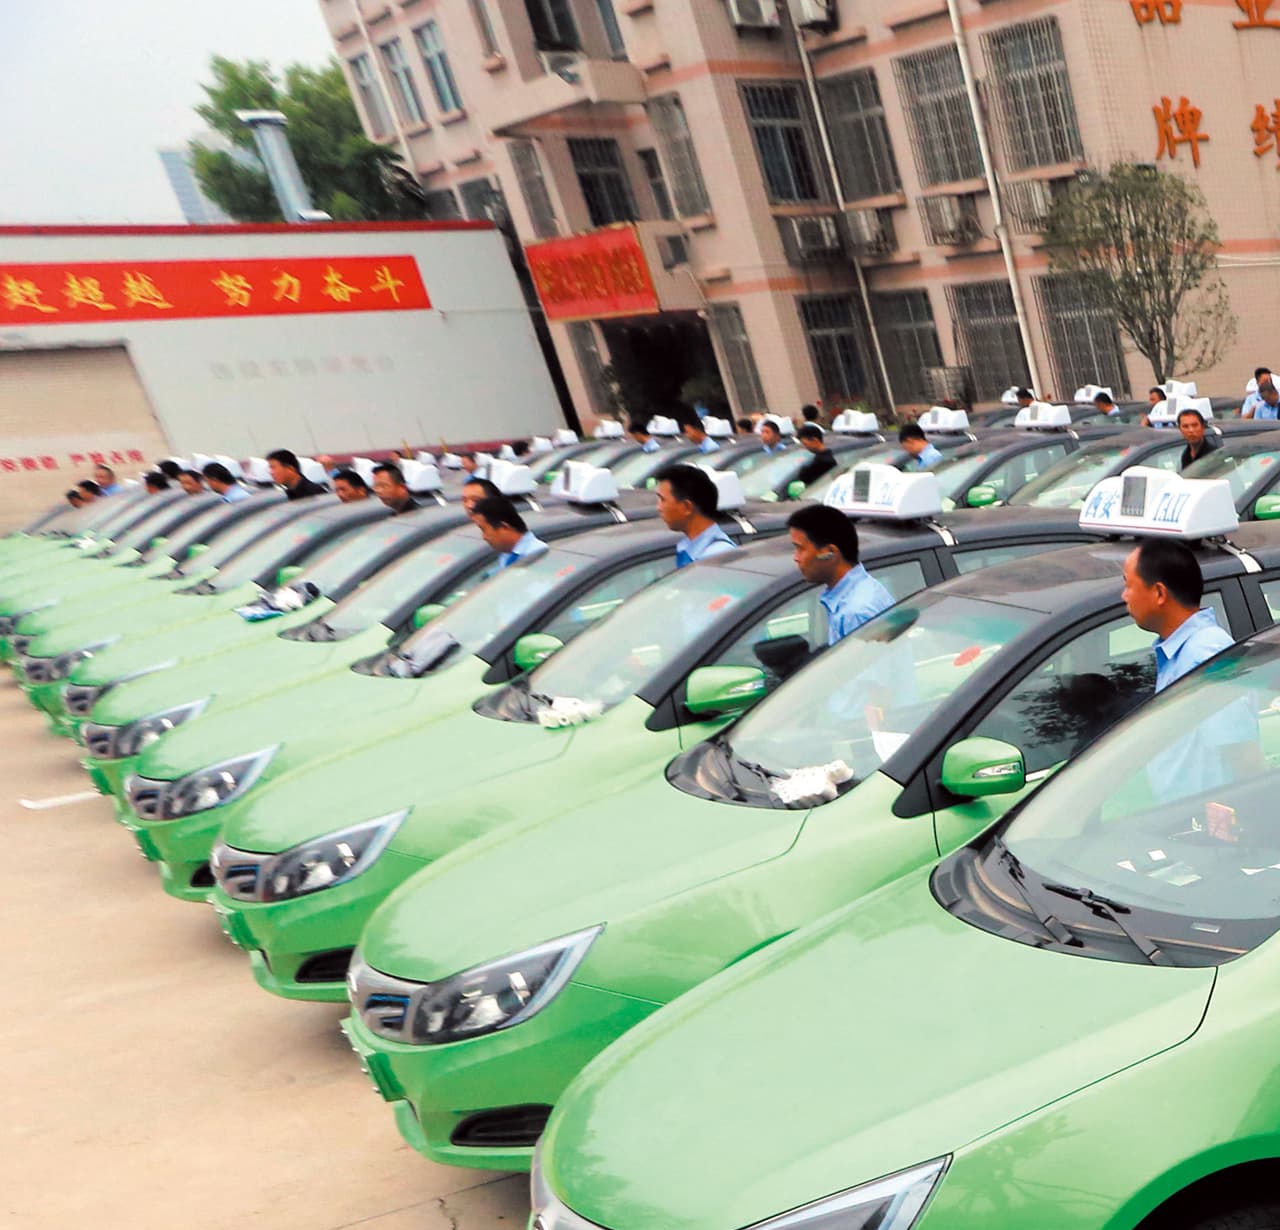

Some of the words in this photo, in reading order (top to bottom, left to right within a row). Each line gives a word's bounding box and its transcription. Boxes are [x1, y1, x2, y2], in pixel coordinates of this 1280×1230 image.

[210, 264, 405, 307] 努力奋斗
[1152, 492, 1191, 524] TAXI
